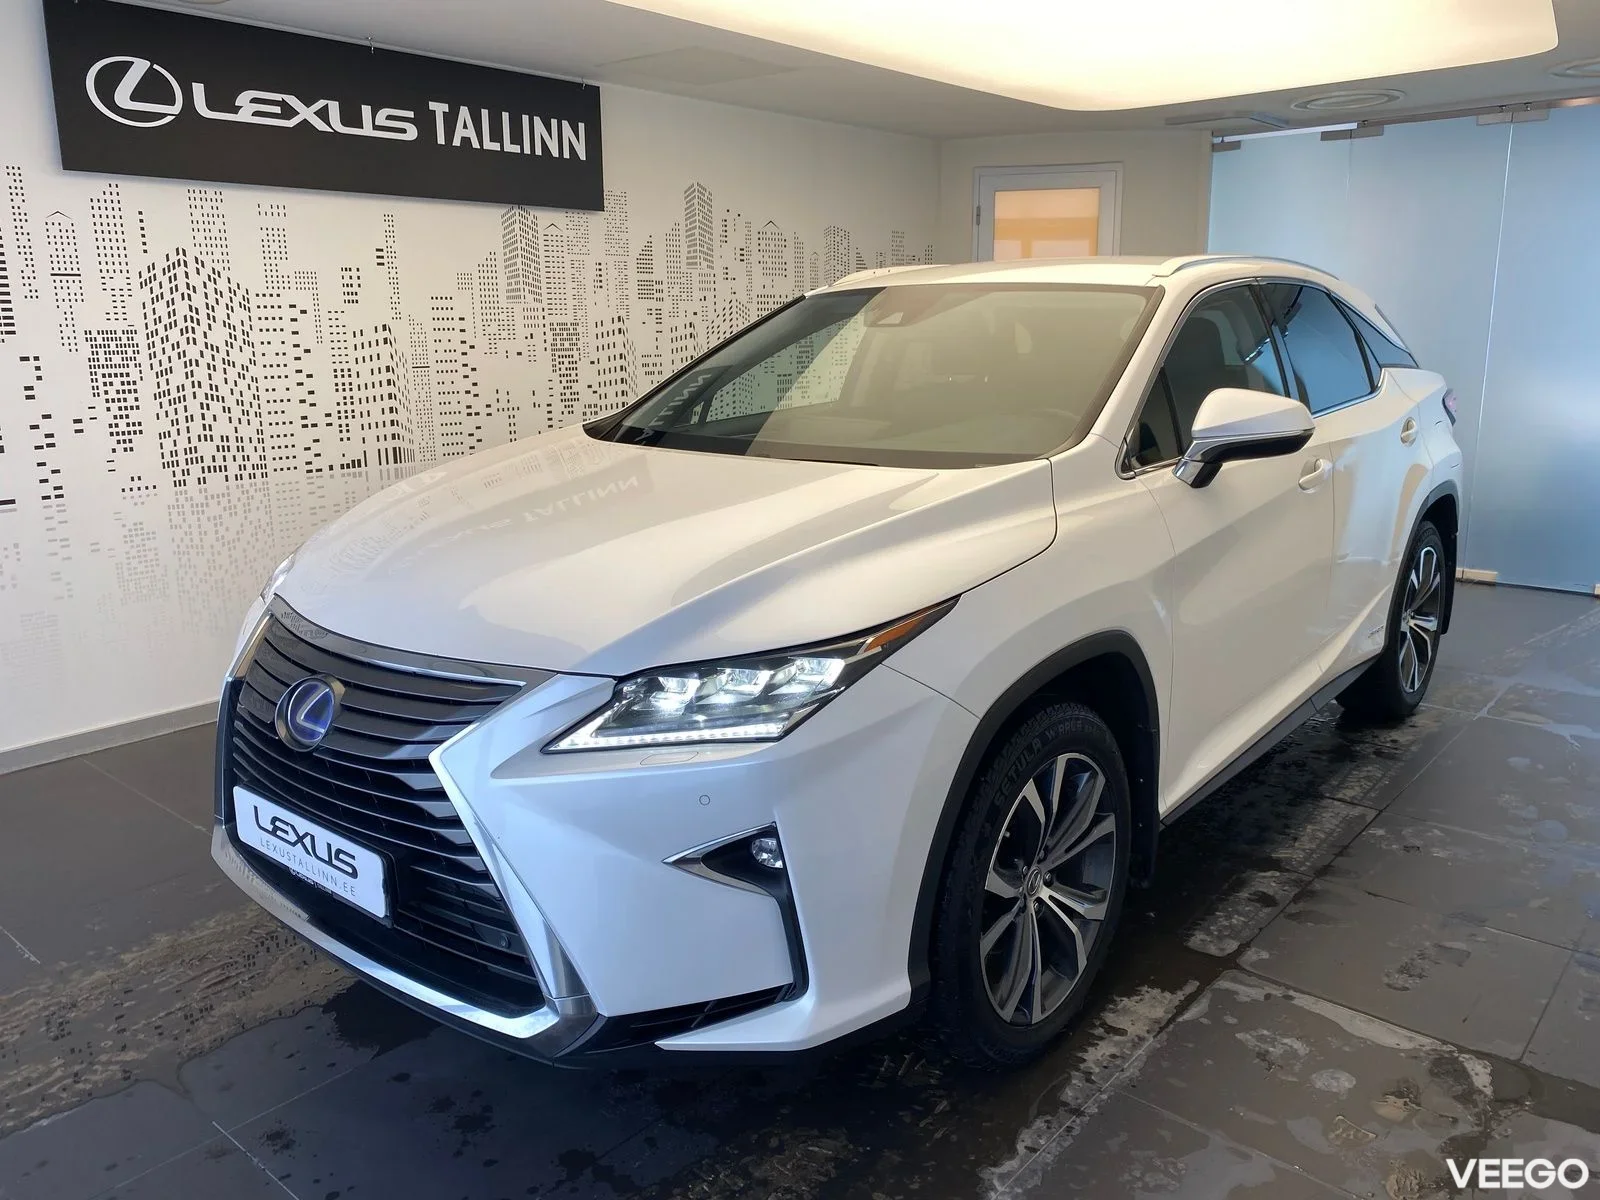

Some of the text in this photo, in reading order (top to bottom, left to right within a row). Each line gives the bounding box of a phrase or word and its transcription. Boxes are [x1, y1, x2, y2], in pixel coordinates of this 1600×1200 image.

[191, 82, 419, 142] LEXUS
[428, 101, 587, 161] TALLINN
[253, 804, 359, 880] LEXUS
[259, 836, 357, 897] LEXUSTALLINN.EE
